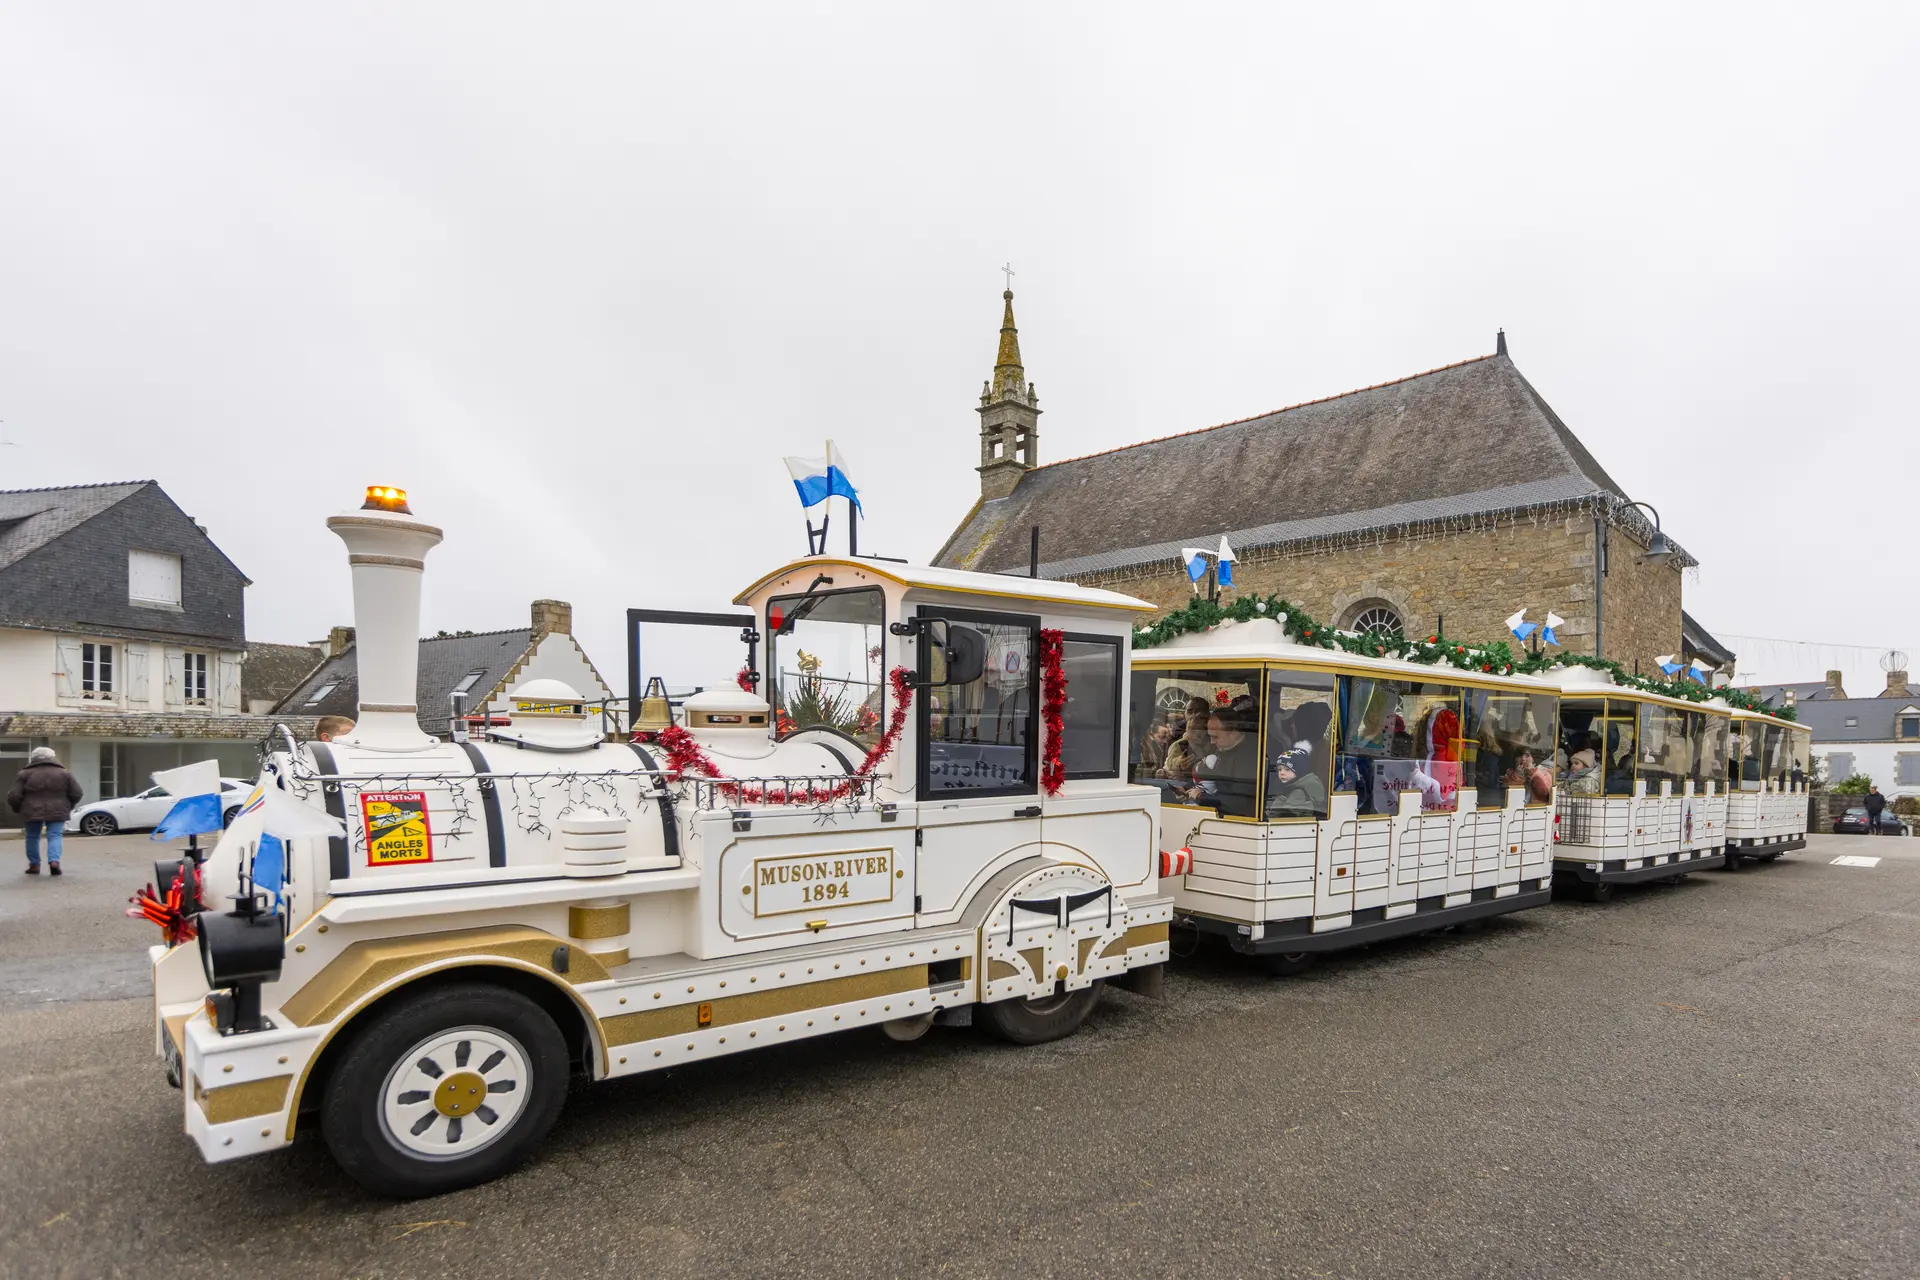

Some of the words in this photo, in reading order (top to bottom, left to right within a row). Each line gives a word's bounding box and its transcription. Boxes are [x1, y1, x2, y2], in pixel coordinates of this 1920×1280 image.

[377, 840, 423, 849] ANGLES
[380, 849, 422, 859] MORTS
[802, 881, 850, 903] 1894
